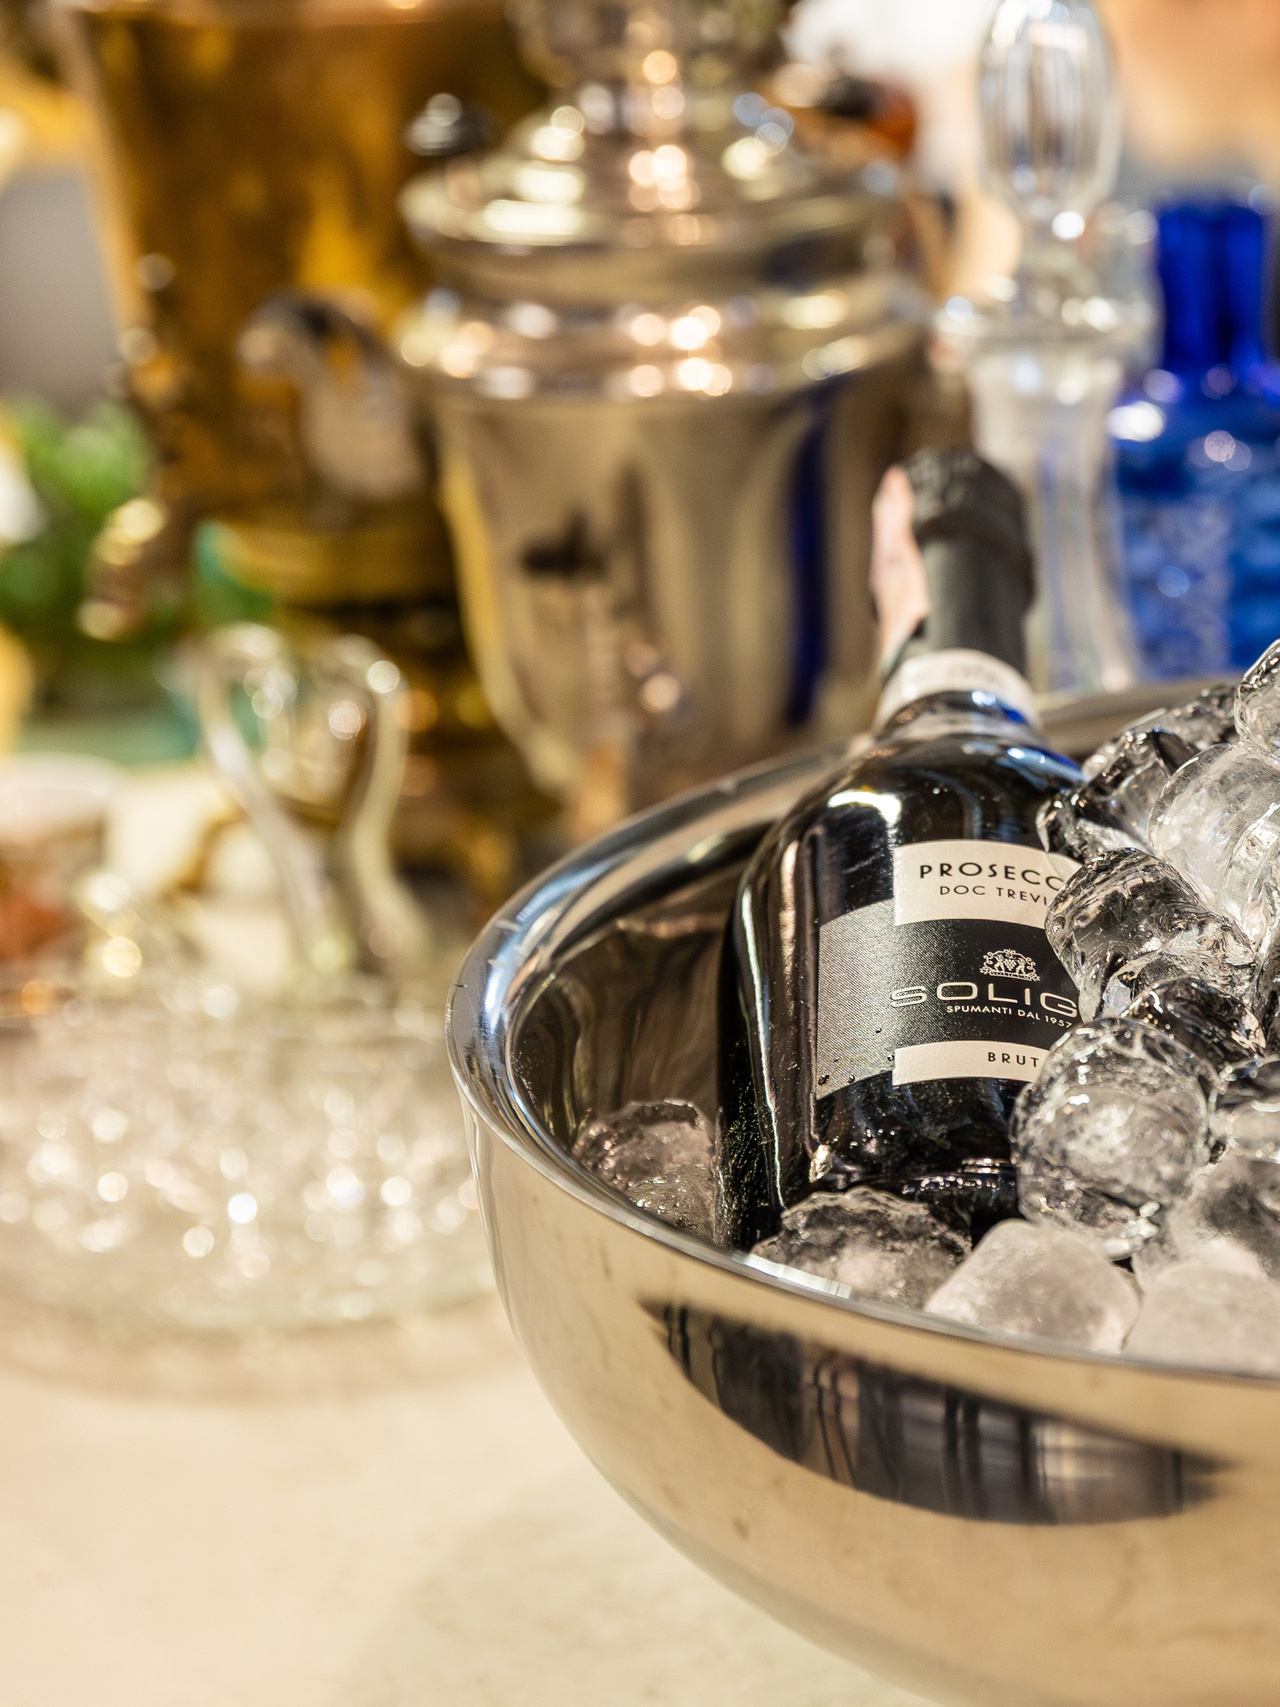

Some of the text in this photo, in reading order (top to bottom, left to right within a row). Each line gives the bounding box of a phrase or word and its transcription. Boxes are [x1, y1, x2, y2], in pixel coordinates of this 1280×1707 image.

[940, 885, 1047, 906] DOC TREVI
[890, 981, 1078, 1019] SOLIG
[946, 1005, 1073, 1029] SPUMANTI DAL 1957
[988, 1051, 1039, 1068] BRUT
